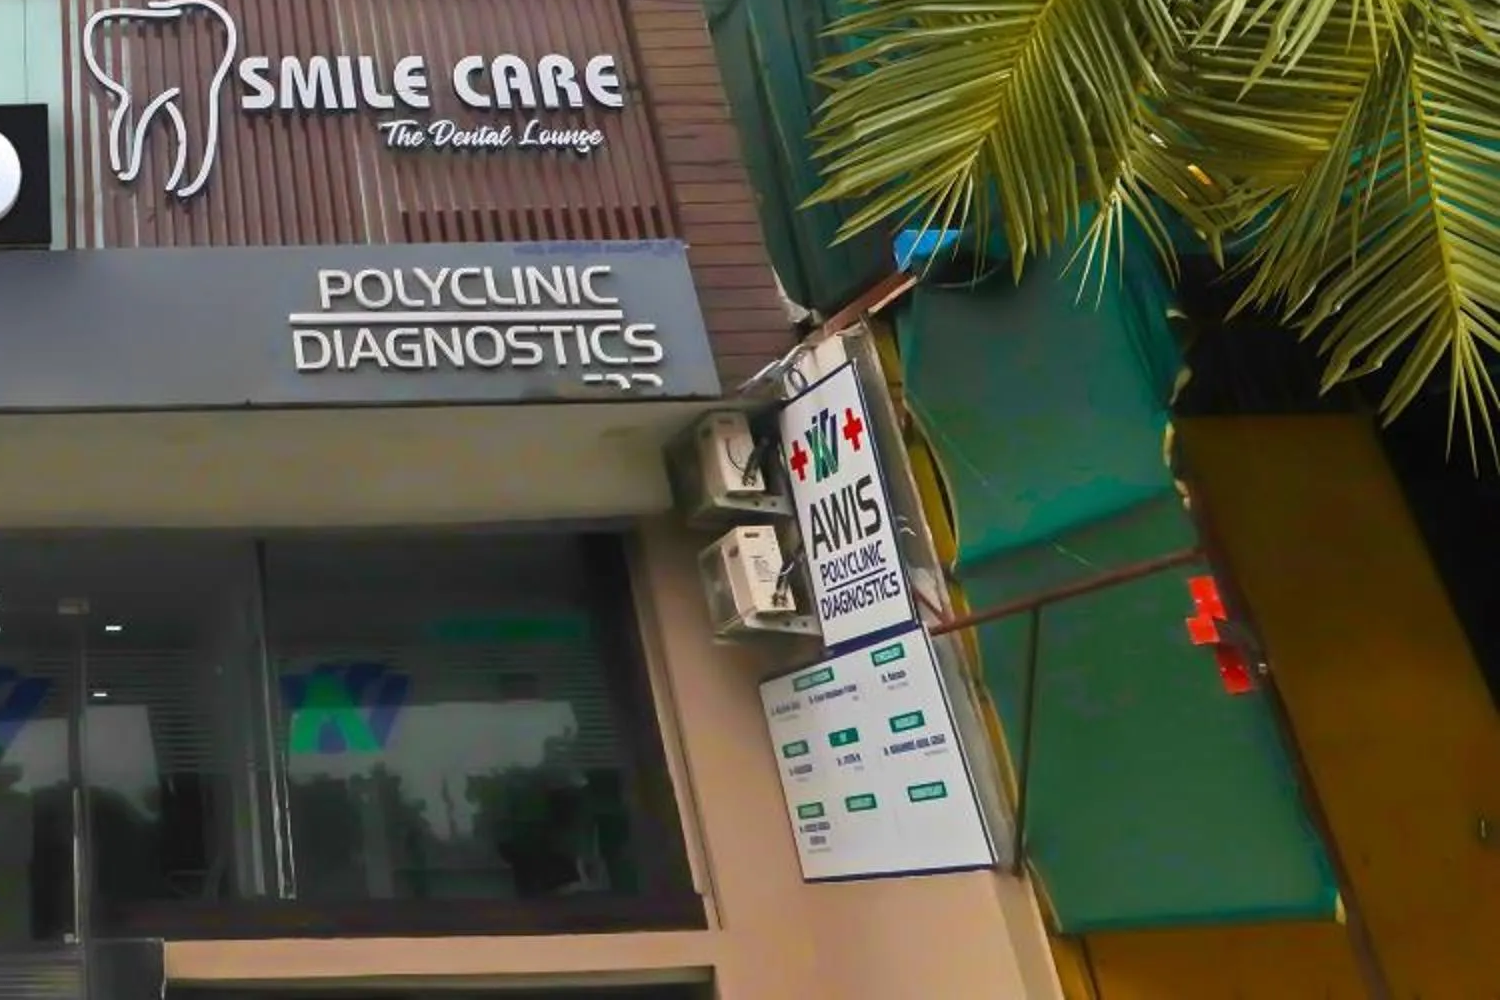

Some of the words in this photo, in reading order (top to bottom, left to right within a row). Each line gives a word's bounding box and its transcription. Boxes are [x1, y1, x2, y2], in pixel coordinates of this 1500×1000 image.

[238, 55, 431, 111] SMILE
[453, 53, 624, 109] CARE
[378, 119, 426, 147] The
[428, 119, 514, 147] Dental
[518, 119, 604, 154] Lounge
[317, 264, 619, 310] POLYCLINIC
[292, 323, 664, 372] DIAGNOSTICS
[810, 474, 882, 560] AWIS
[819, 540, 887, 586] POLYCLINIC
[819, 571, 901, 621] DIAGNOSTICS
